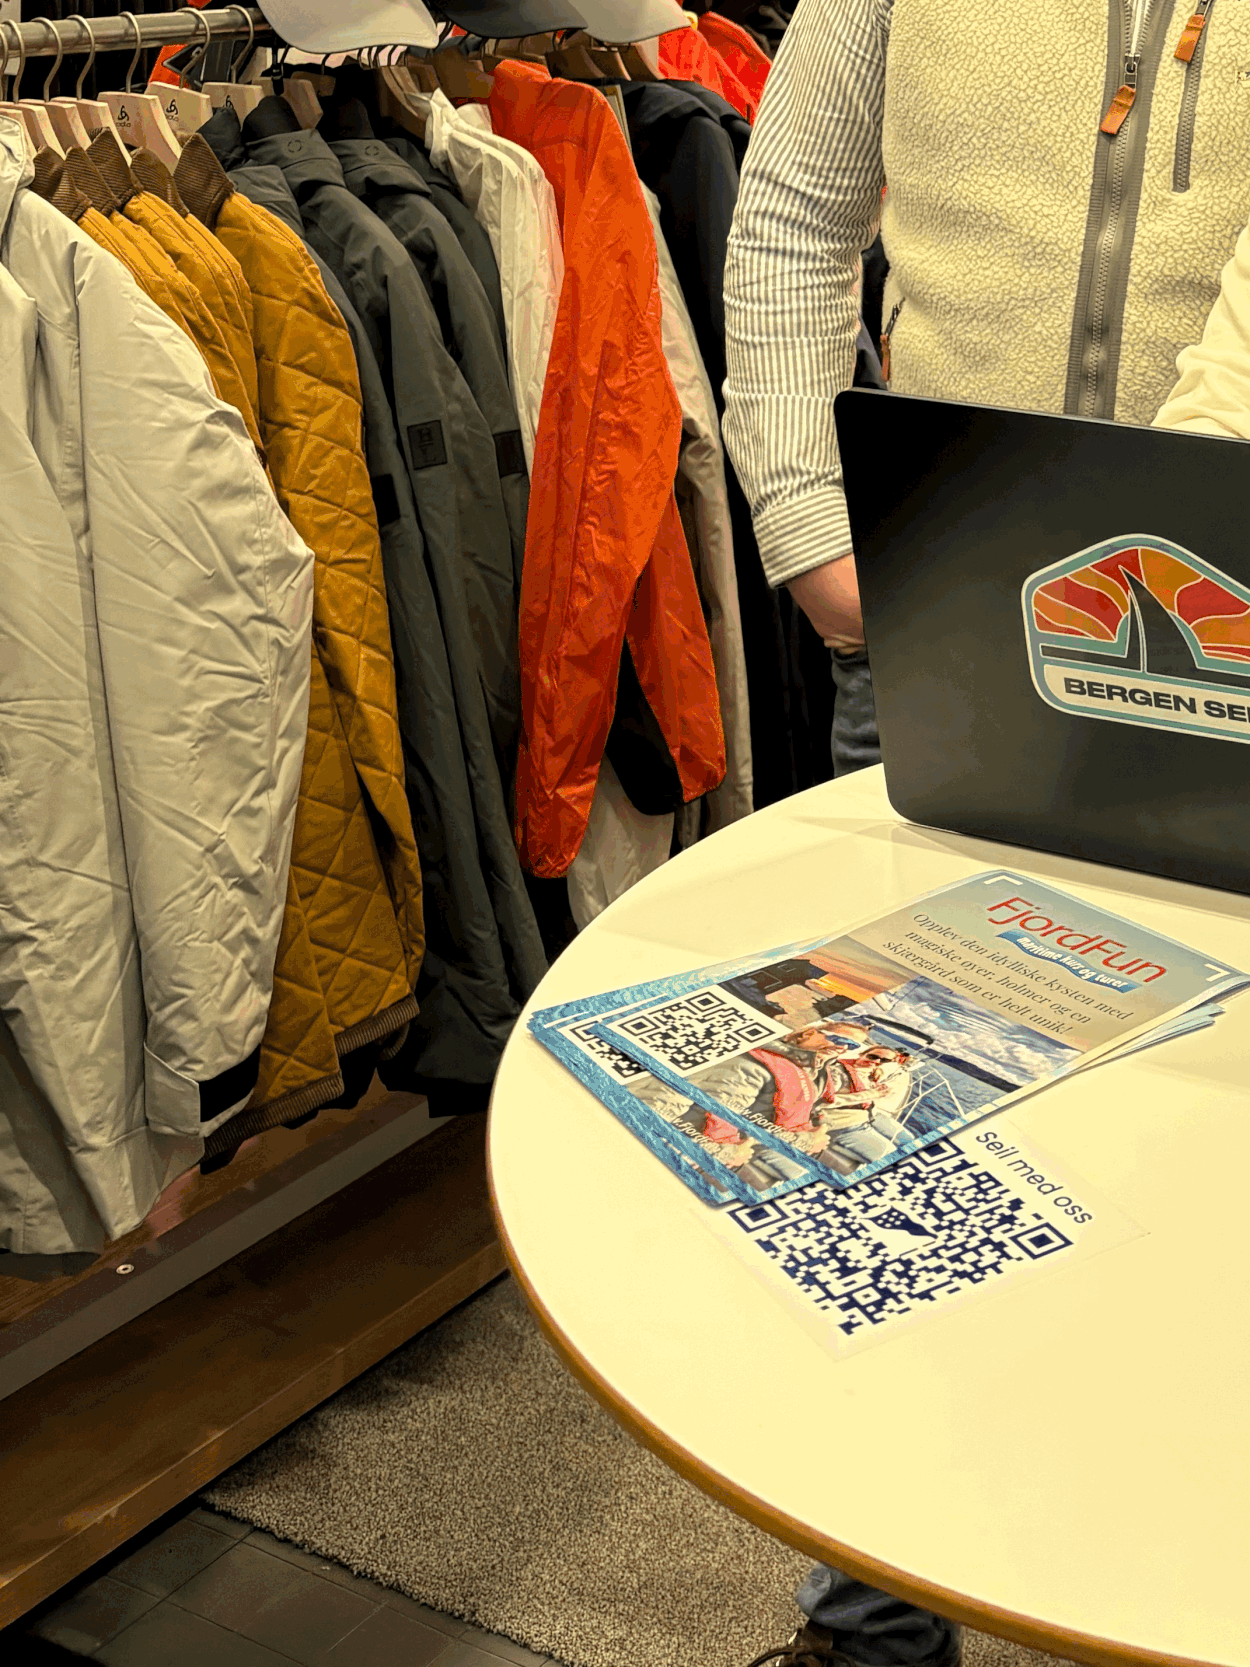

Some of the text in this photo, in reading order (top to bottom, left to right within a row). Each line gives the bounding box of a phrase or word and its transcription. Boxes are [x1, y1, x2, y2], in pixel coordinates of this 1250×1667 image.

[1063, 677, 1197, 714] BERGEN
[913, 914, 1134, 1020] Opplev den idylliske kysten med
[986, 896, 1168, 983] FjordFun
[1016, 936, 1063, 961] maritime
[1078, 967, 1098, 981] og
[1094, 973, 1130, 989] turer
[904, 931, 962, 962] magiske
[995, 976, 1052, 1005] holmer
[1049, 1002, 1073, 1016] og
[1070, 1011, 1092, 1024] en
[949, 970, 983, 993] som
[981, 989, 1002, 1002] er
[998, 997, 1032, 1016] helt
[1029, 1012, 1074, 1035] unik!
[1006, 1159, 1064, 1195] med
[1053, 1196, 1093, 1224] oss
